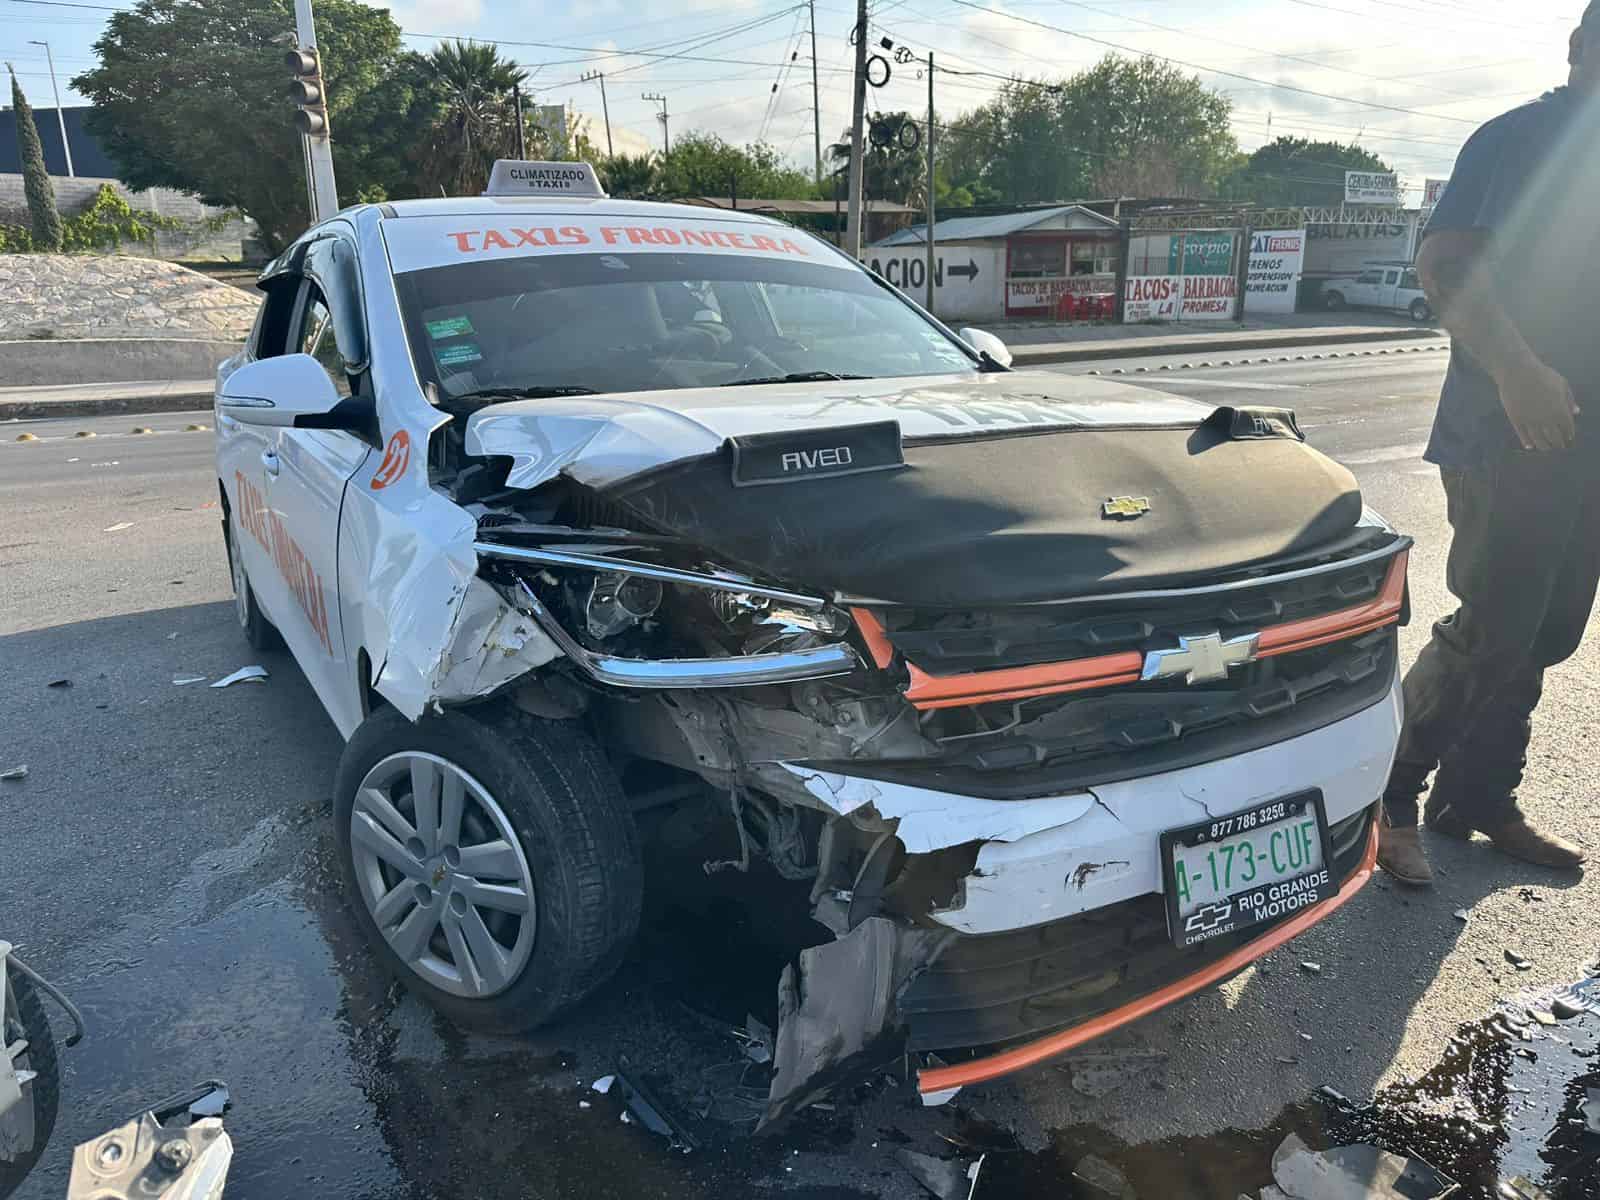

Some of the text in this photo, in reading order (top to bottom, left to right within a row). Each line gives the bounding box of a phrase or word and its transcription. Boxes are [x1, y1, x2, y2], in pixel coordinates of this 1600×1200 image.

[510, 168, 585, 181] CLIMATIZADO
[447, 225, 809, 256] TAXIS FRONTERA
[860, 257, 944, 289] ACION
[1125, 279, 1169, 302] TACOS
[1183, 276, 1237, 299] BARBACOA
[1157, 302, 1174, 315] LA
[1181, 300, 1228, 314] PROMESA
[781, 446, 852, 472] AVEO
[1210, 803, 1285, 838] 877 786 3250
[1175, 821, 1315, 904] A-173-CUF
[1239, 870, 1329, 912] RIO GRANDE
[1255, 889, 1318, 921] MOTORS
[1185, 922, 1236, 945] CHEVROLET
